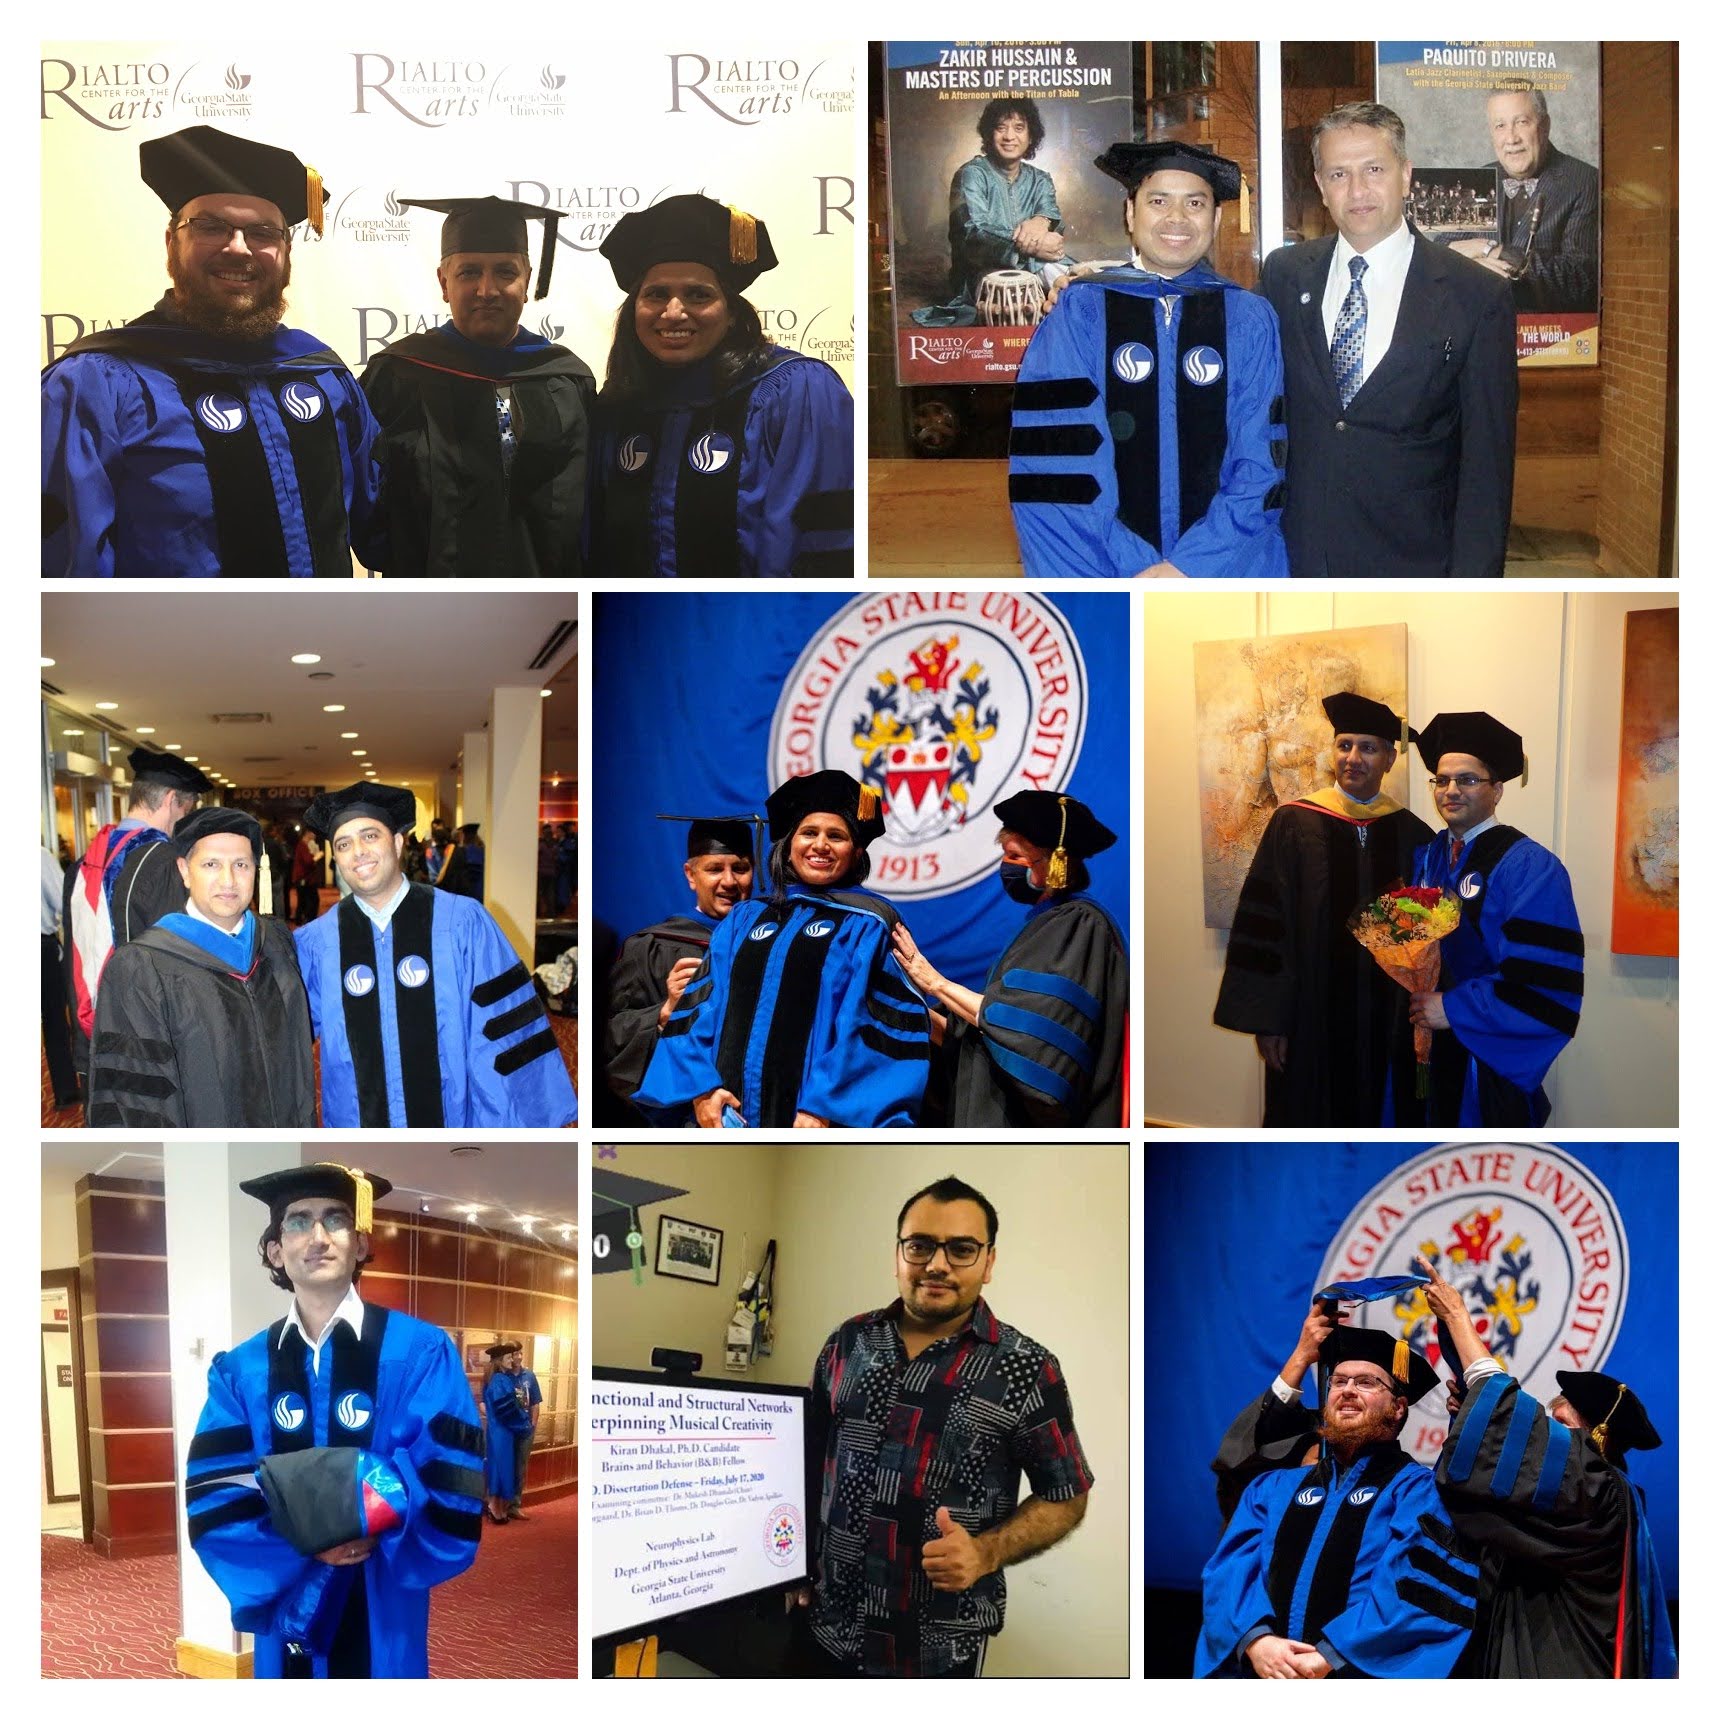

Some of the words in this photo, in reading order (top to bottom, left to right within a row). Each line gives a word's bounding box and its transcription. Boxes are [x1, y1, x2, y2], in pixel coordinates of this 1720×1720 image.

[940, 50, 987, 67] ZAKIR
[992, 48, 1062, 66] HUSSAIN
[1065, 48, 1077, 66] &
[1423, 48, 1486, 66] PAQUITO
[1491, 50, 1557, 68] D'RIVERA
[906, 70, 980, 89] MASTERS
[984, 69, 1004, 87] OF
[1009, 68, 1112, 87] PERCUSSION
[1495, 80, 1531, 91] University
[41, 59, 169, 131] RIALTO
[81, 89, 121, 98] CENTER
[125, 88, 145, 97] FOR
[151, 88, 169, 97] THE
[349, 53, 486, 128] RIALTO
[400, 86, 439, 94] CENTER
[442, 86, 462, 94] FOR
[467, 86, 485, 94] THE
[664, 54, 799, 125] RIALTO
[714, 85, 752, 94] CENTER
[756, 85, 776, 93] FOR
[781, 84, 799, 92] THE
[939, 91, 950, 100] An
[951, 91, 990, 100] Afternoon
[992, 90, 1009, 99] with
[1011, 90, 1024, 99] the
[1026, 90, 1046, 98] Titan
[1048, 89, 1056, 98] of
[1058, 89, 1080, 98] Tabla
[109, 97, 163, 121] arts
[194, 106, 251, 119] University
[425, 95, 479, 116] arts
[739, 92, 793, 115] arts
[597, 211, 617, 219] FOR
[355, 229, 410, 244] University
[778, 333, 797, 342] THE
[1523, 332, 1539, 343] THE
[1540, 332, 1571, 343] WORLD
[909, 336, 962, 364] RIALTO
[938, 350, 960, 360] arts
[786, 634, 860, 779] EORGIA
[861, 592, 969, 637] STATE
[980, 592, 1071, 791] UNIVERSITY
[876, 853, 941, 882] 1913
[1406, 1152, 1516, 1206] STATE
[1523, 1160, 1612, 1371] UNIVERSITY
[658, 1393, 683, 1409] and
[686, 1394, 745, 1411] Structural
[748, 1398, 793, 1414] Networks
[670, 1414, 719, 1430] Musical
[722, 1416, 774, 1434] Creativity
[610, 1445, 638, 1456] Kiran
[640, 1443, 676, 1455] Dhakal,
[703, 1443, 740, 1453] Candidate
[601, 1461, 634, 1473] Brains
[636, 1460, 653, 1471] and
[655, 1459, 693, 1470] Behavior
[722, 1456, 746, 1466] Fellow
[603, 1481, 659, 1495] Dissertation
[661, 1479, 693, 1489] Defense
[645, 1536, 700, 1552] Neurophysics
[700, 1531, 716, 1542] Lab
[614, 1567, 640, 1579] Dept.
[642, 1560, 652, 1571] of
[653, 1556, 684, 1571] Physics
[684, 1552, 699, 1563] and
[700, 1545, 739, 1561] Astronomy
[631, 1580, 667, 1595] Georgia
[668, 1575, 688, 1586] State
[689, 1565, 726, 1581] University
[683, 1581, 714, 1597] Georgia
